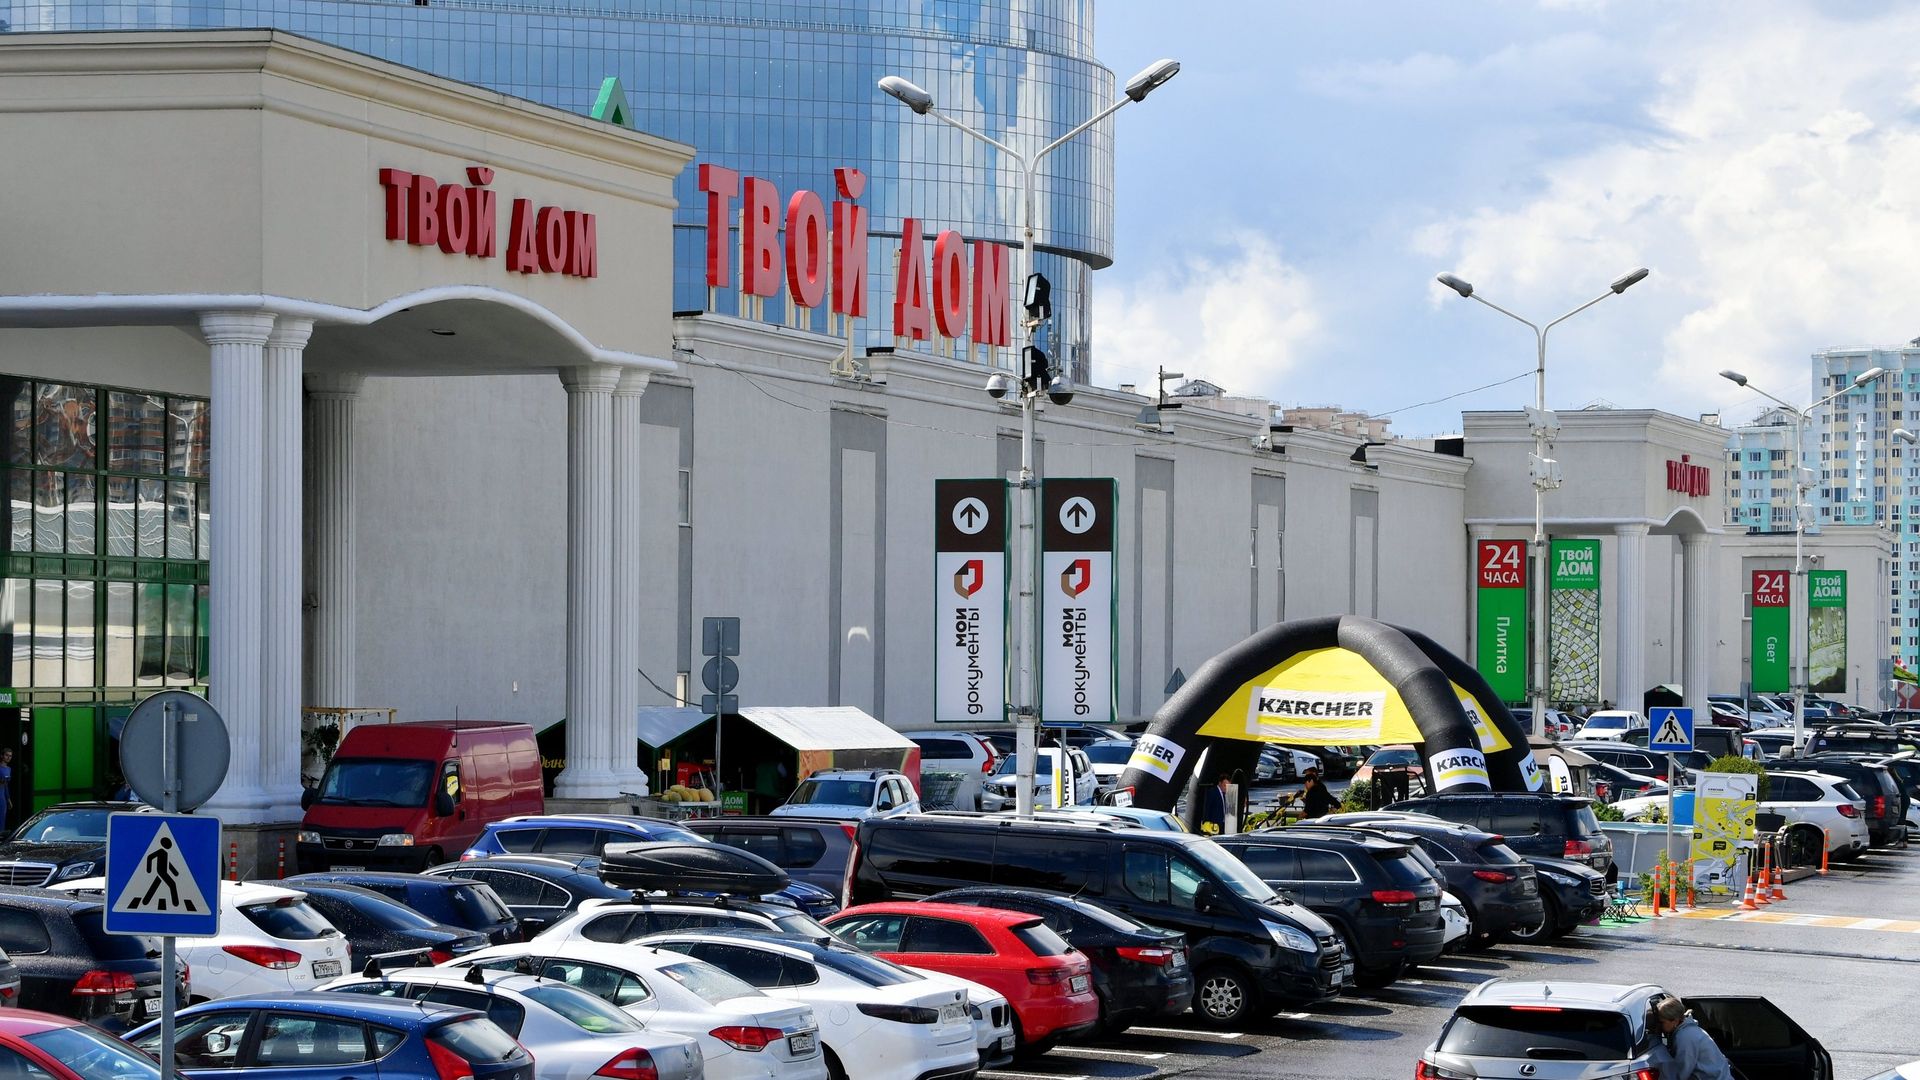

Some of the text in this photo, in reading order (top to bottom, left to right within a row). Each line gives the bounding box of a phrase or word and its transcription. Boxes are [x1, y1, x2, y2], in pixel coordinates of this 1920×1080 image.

[379, 166, 597, 278] ТВОЙ ДОМ
[699, 163, 1011, 347] ТВОЙ ДОМ
[1484, 545, 1520, 569] 24
[1559, 547, 1593, 560] ТВОЙ
[1484, 571, 1520, 584] ЧАСА
[1557, 561, 1594, 576] ДОМ
[1757, 575, 1785, 593] 24
[1814, 575, 1841, 586] ТВОЙ
[1757, 594, 1785, 604] ЧАСА
[1813, 586, 1842, 598] ДОМ
[1496, 616, 1510, 674] Плитка
[1767, 636, 1778, 663] Свет
[1258, 697, 1374, 716] KÄRCHER
